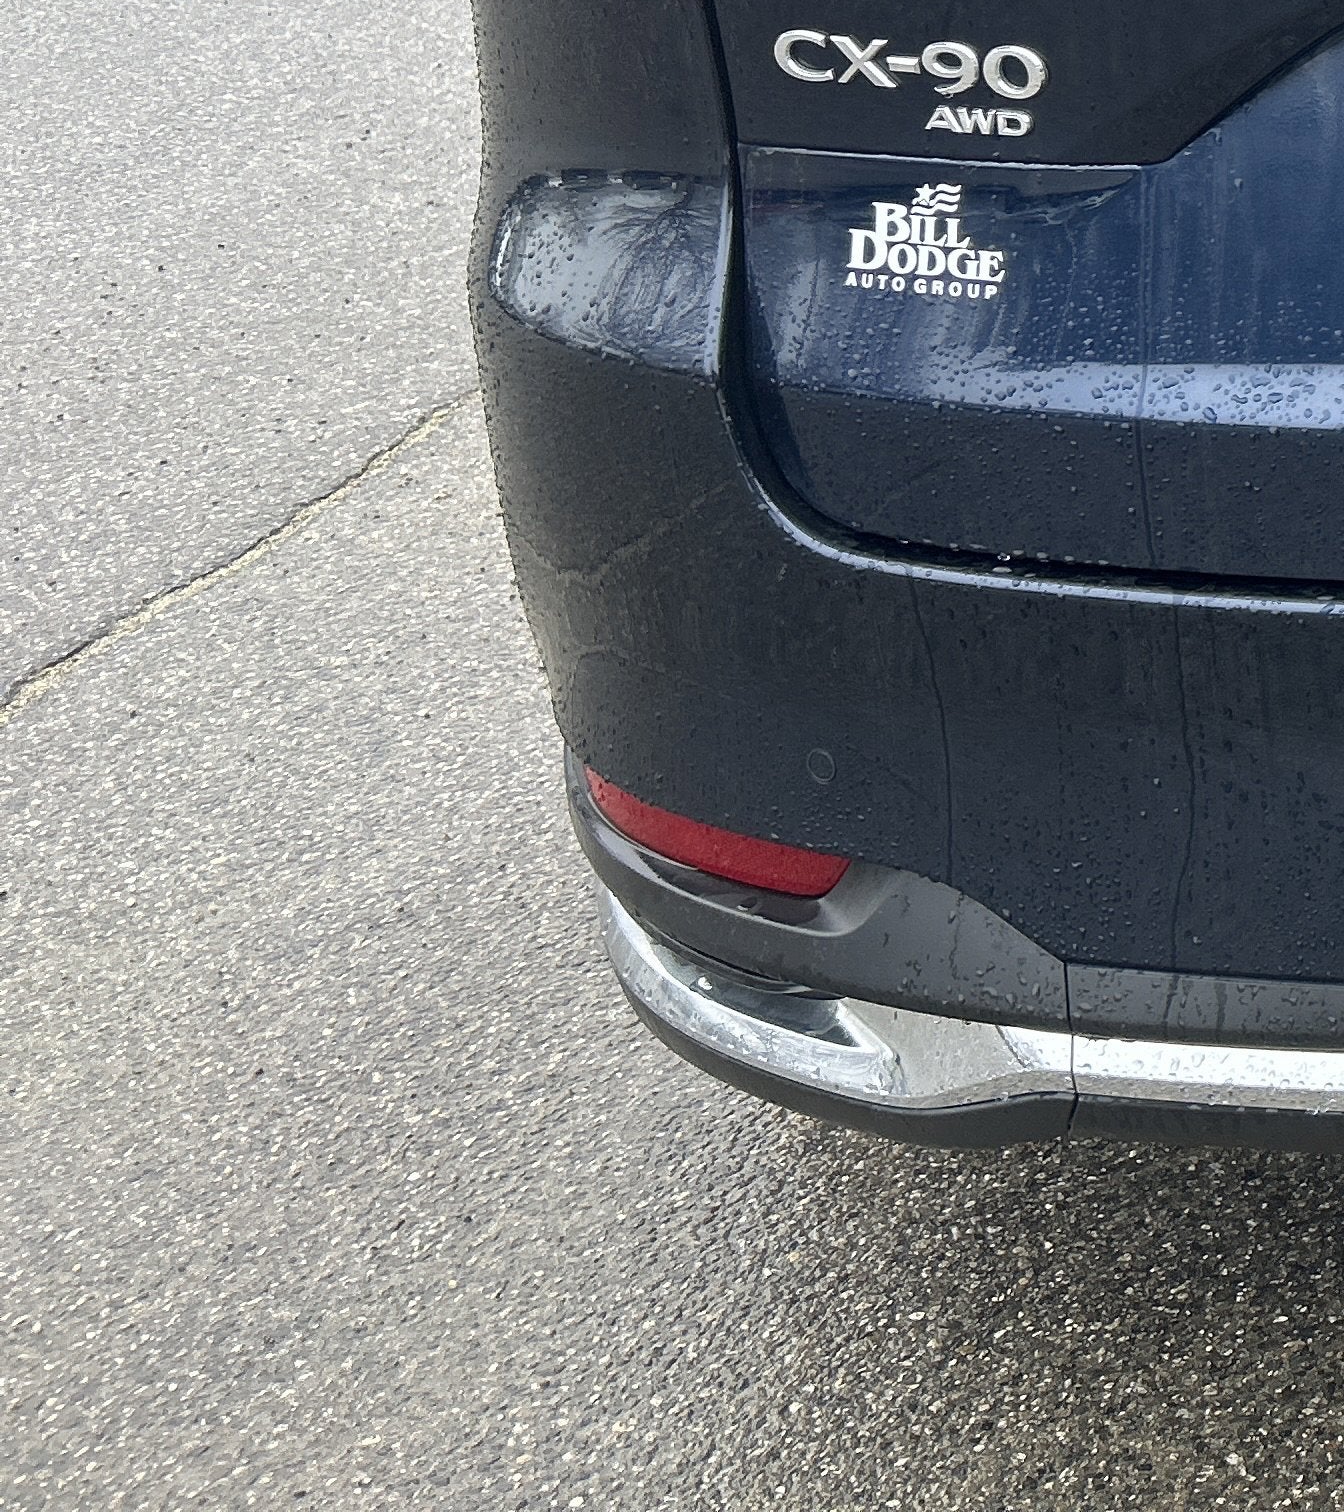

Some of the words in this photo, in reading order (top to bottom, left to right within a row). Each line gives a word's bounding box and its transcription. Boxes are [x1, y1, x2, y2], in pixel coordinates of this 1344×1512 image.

[773, 29, 1048, 100] CX-90
[924, 105, 1034, 137] AWD
[870, 201, 972, 249] BILL
[845, 227, 1006, 283] DODGE
[844, 272, 906, 292] AUTO
[913, 277, 999, 300] GROUP
